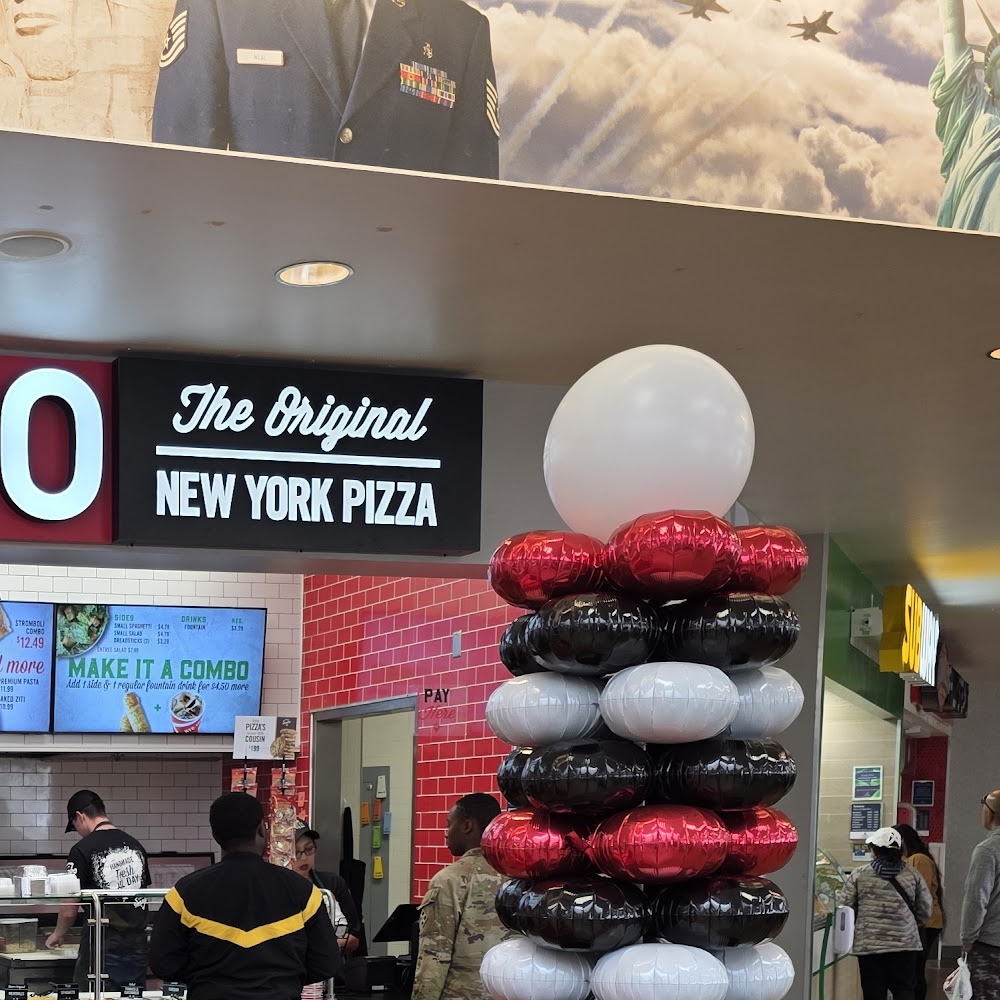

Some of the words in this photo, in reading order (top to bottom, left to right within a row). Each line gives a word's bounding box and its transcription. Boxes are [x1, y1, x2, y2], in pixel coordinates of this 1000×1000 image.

[173, 383, 254, 434] The
[265, 386, 433, 452] Original
[156, 470, 236, 520] NEW
[245, 475, 330, 523] YORK
[343, 479, 437, 527] PIZZA
[15, 619, 45, 628] STROMBOLI
[114, 614, 135, 622] SIDES
[181, 615, 207, 623] DRINKS
[26, 627, 45, 635] COMBO
[16, 636, 45, 649] $12.49
[6, 658, 46, 675] more
[68, 657, 128, 679] MAKE
[135, 658, 154, 680] IT
[160, 659, 173, 680] A
[180, 659, 249, 681] COMBO
[23, 678, 40, 686] PASTA
[66, 679, 81, 689] Add
[86, 679, 102, 689] side
[117, 680, 145, 692] regular
[145, 680, 176, 692] fountain
[177, 681, 196, 691] drink
[230, 683, 250, 691] more
[424, 688, 450, 703] PAY
[421, 706, 457, 721] Here
[245, 723, 267, 731] PIZZA'S
[245, 735, 265, 743] COUSIN
[126, 874, 139, 886] DAY
